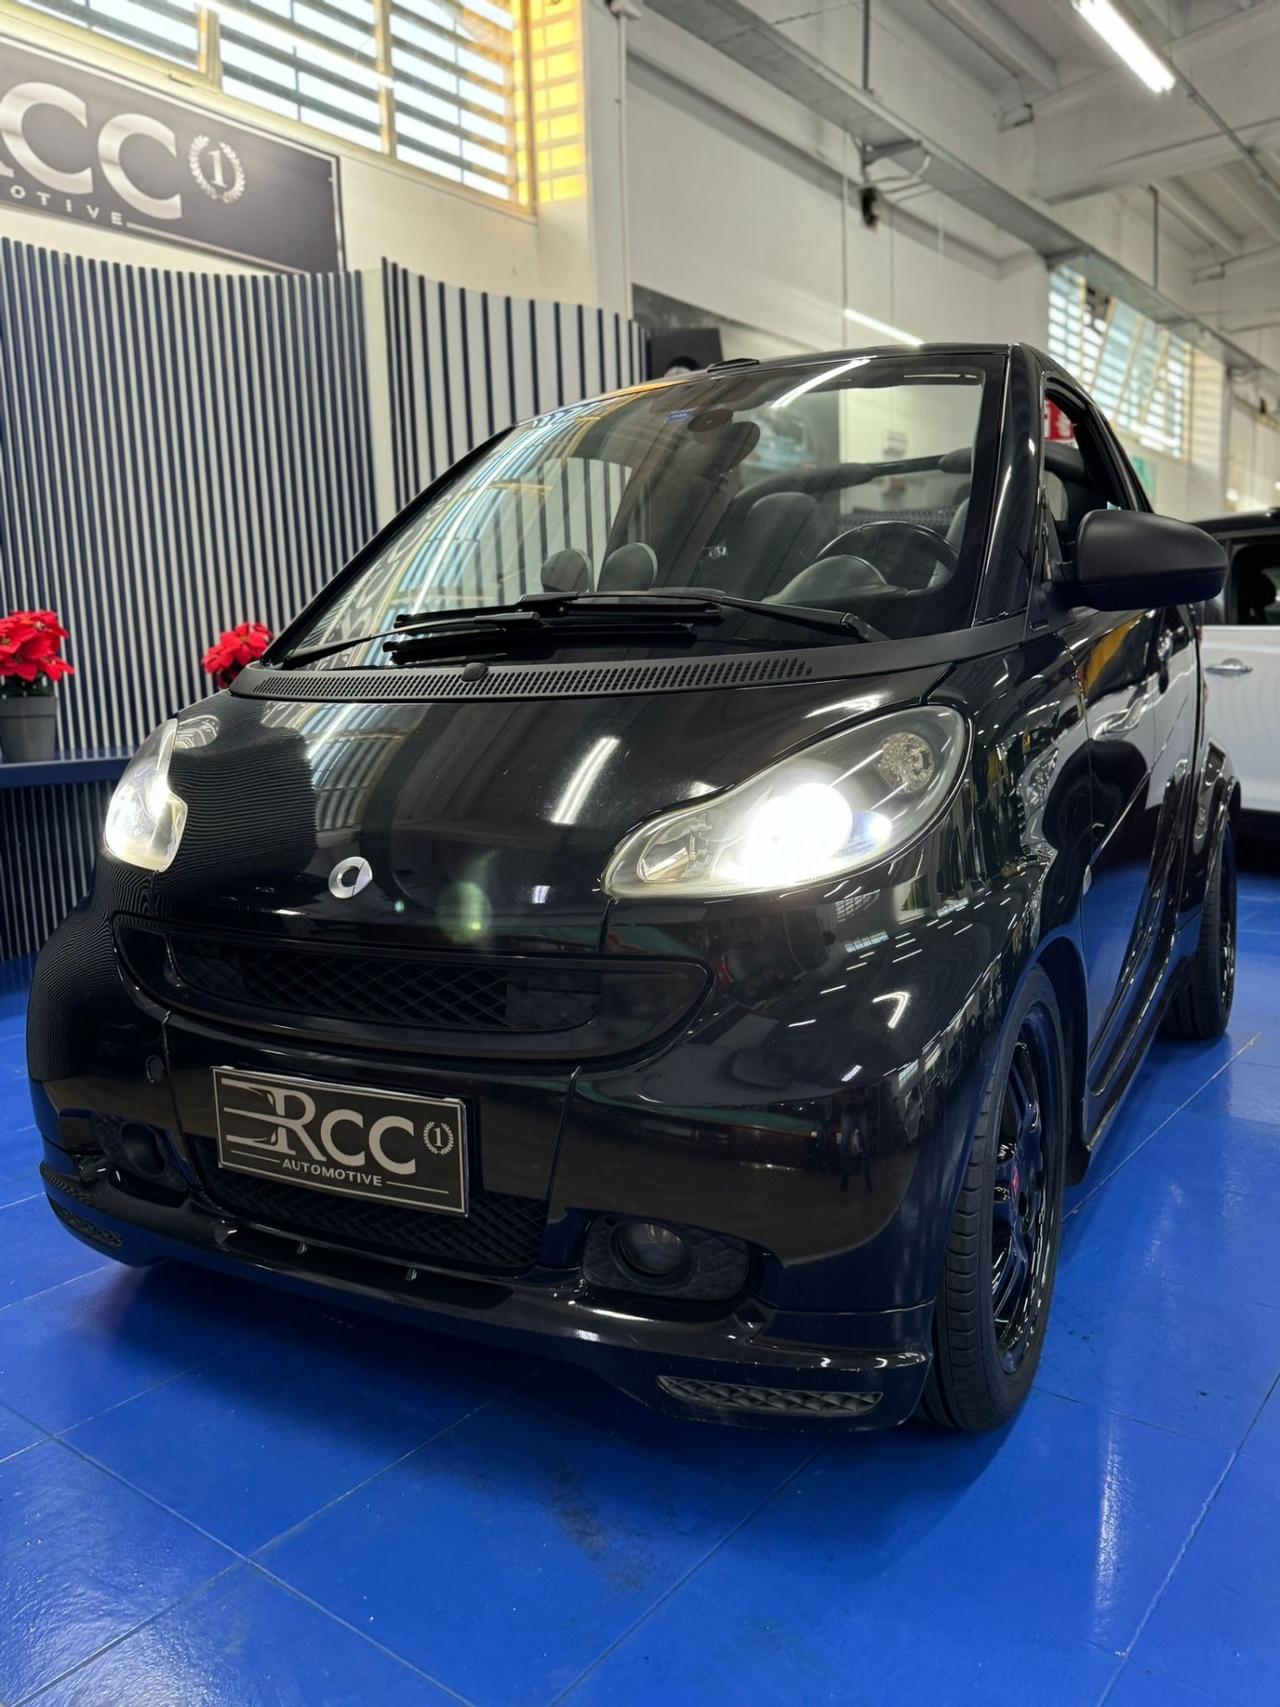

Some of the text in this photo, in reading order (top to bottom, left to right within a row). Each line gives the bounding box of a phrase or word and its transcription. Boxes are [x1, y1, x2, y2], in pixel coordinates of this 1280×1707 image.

[0, 82, 183, 220] CC
[8, 184, 123, 226] OTIVE
[260, 1085, 416, 1175] RCC
[282, 1158, 382, 1187] AUTOMOTIVE
